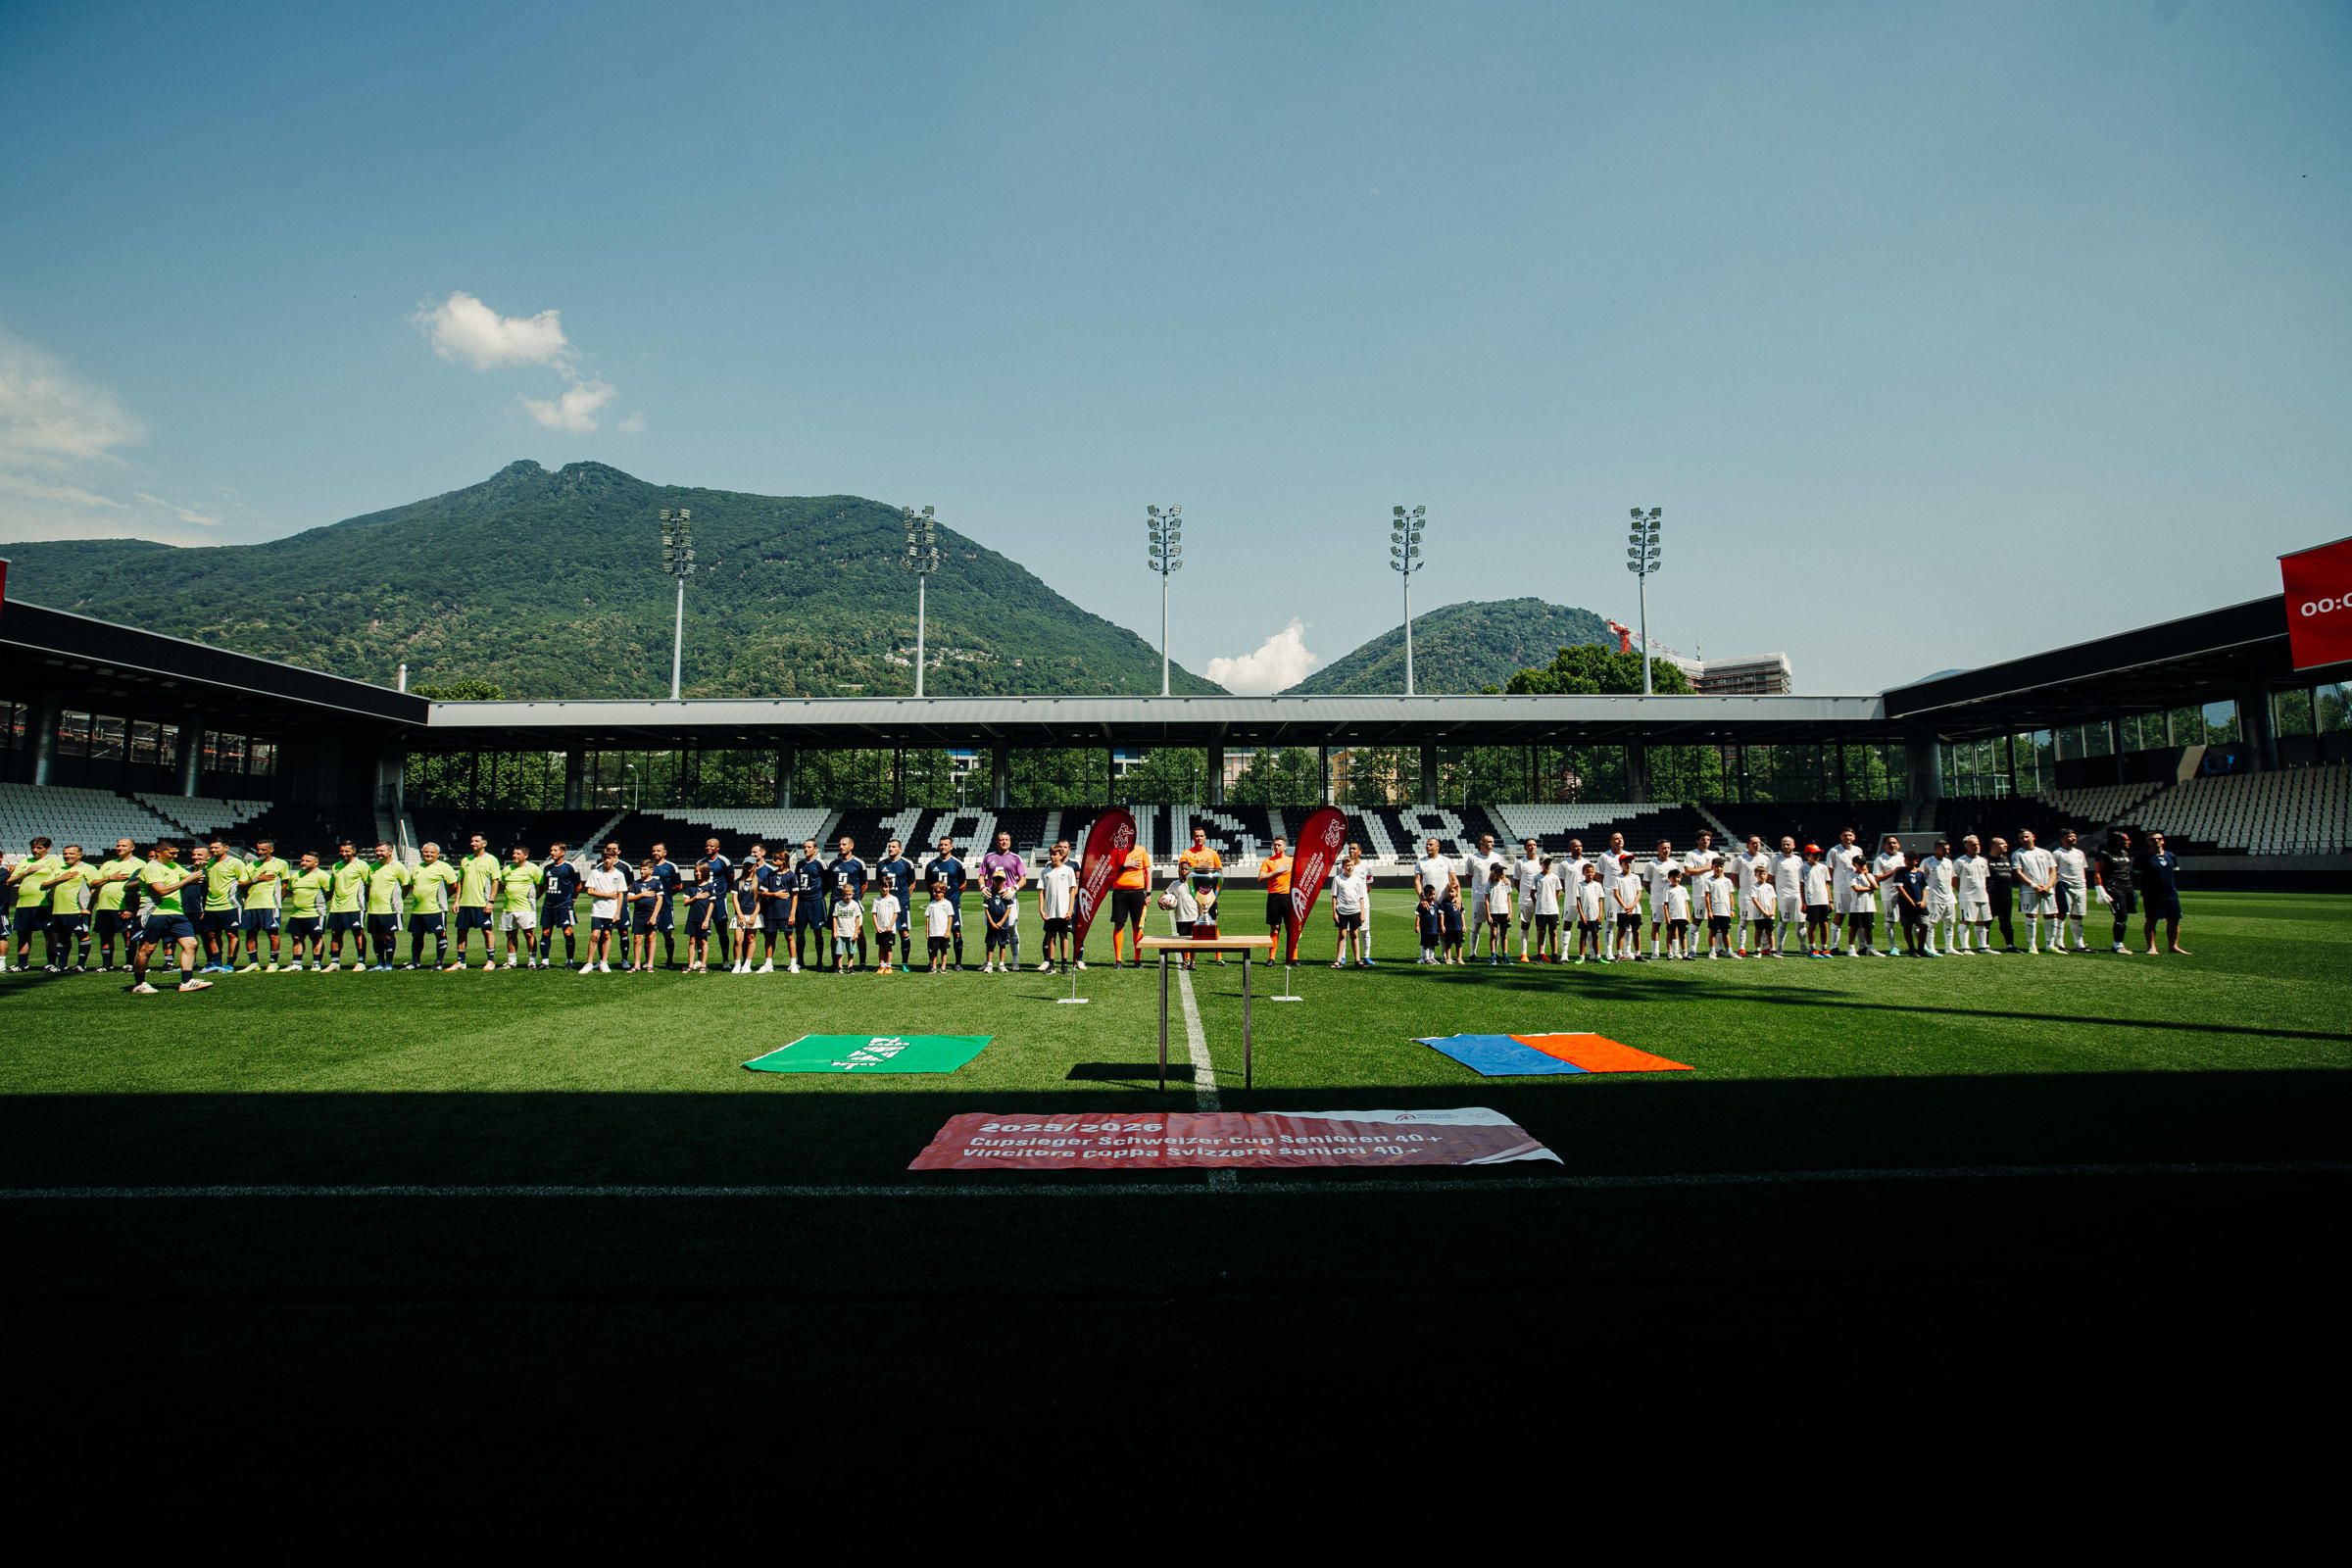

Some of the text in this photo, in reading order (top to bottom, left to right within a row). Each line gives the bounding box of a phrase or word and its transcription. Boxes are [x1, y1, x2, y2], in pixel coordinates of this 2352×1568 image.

[979, 1122, 1163, 1133] 2025/2026
[969, 1137, 1093, 1148] Cupsieger
[1098, 1136, 1223, 1146] Schweizer
[1280, 1134, 1389, 1144] Senioren
[1396, 1134, 1443, 1143] 40+
[963, 1149, 1076, 1157] Vincitore
[1166, 1147, 1272, 1157] Svizzera
[1374, 1146, 1423, 1155] 40+
